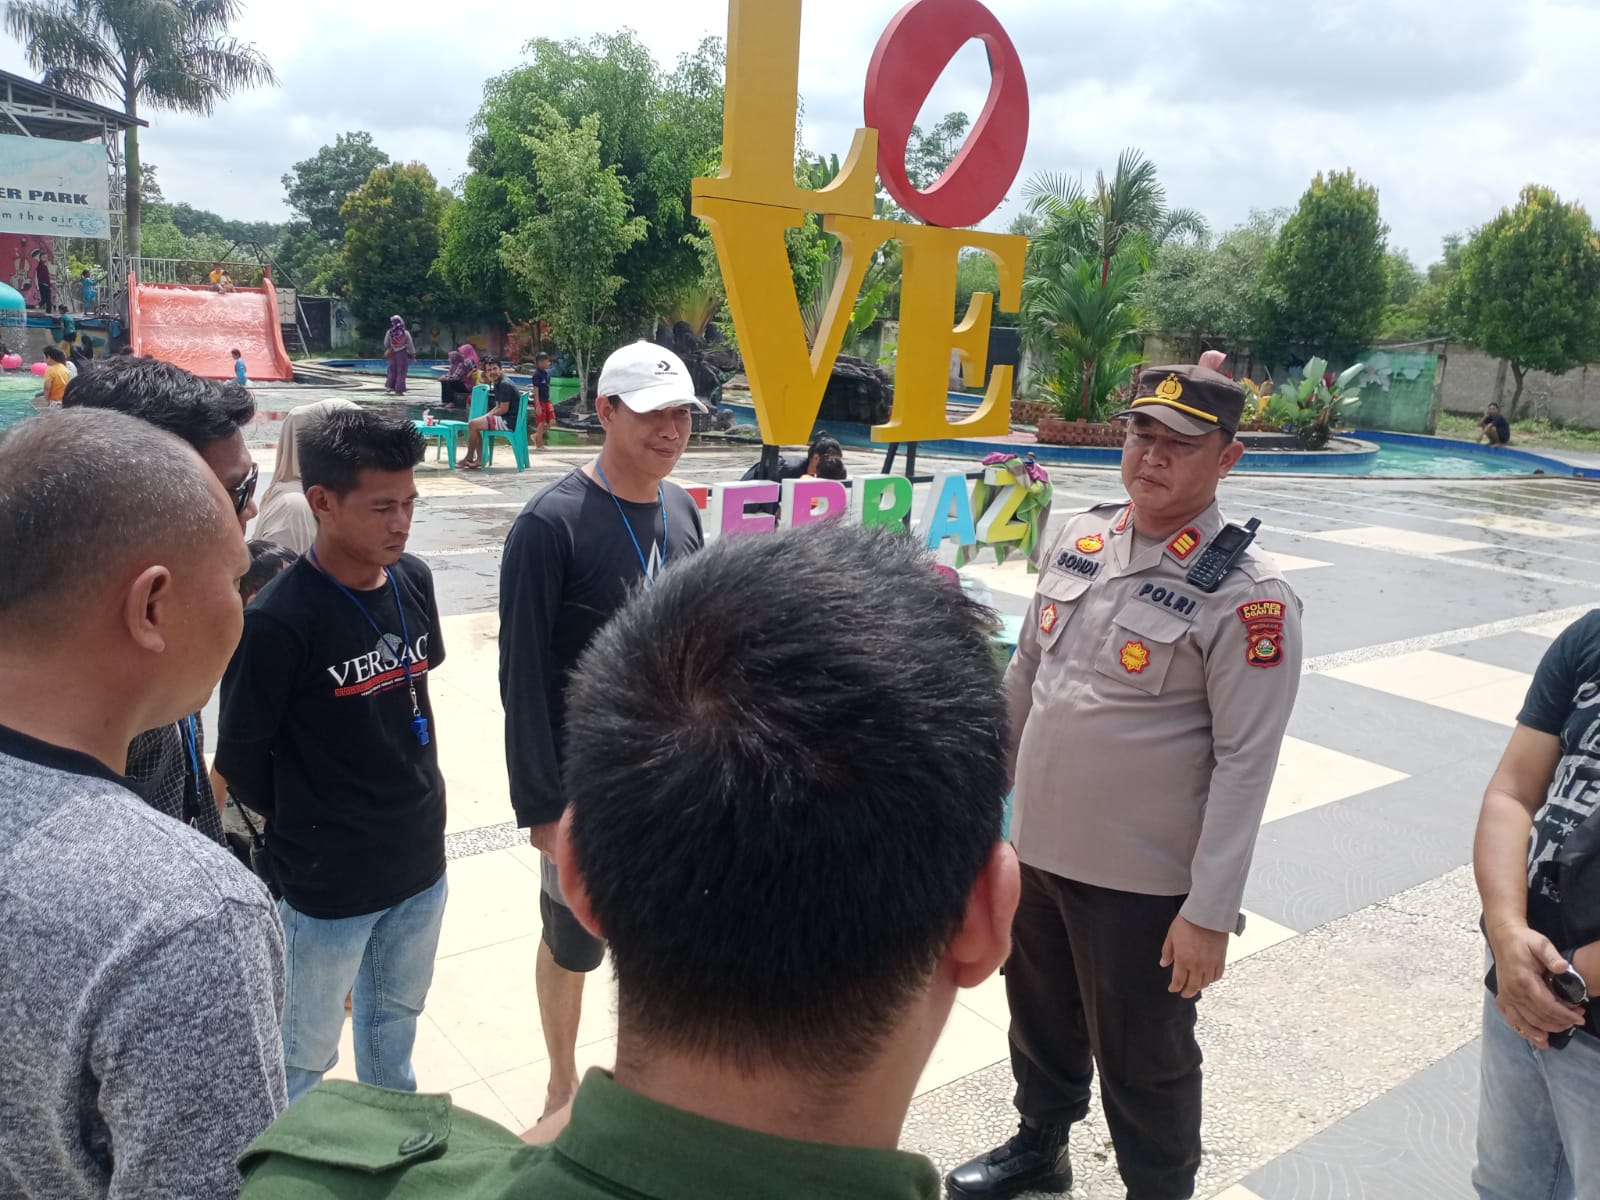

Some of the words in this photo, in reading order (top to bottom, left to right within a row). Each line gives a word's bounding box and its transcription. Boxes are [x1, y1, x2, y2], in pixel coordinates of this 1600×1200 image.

[28, 190, 89, 204] PARK
[19, 210, 45, 222] the
[51, 214, 74, 224] air
[1057, 552, 1100, 577] SONDI
[1138, 582, 1197, 616] POLRI
